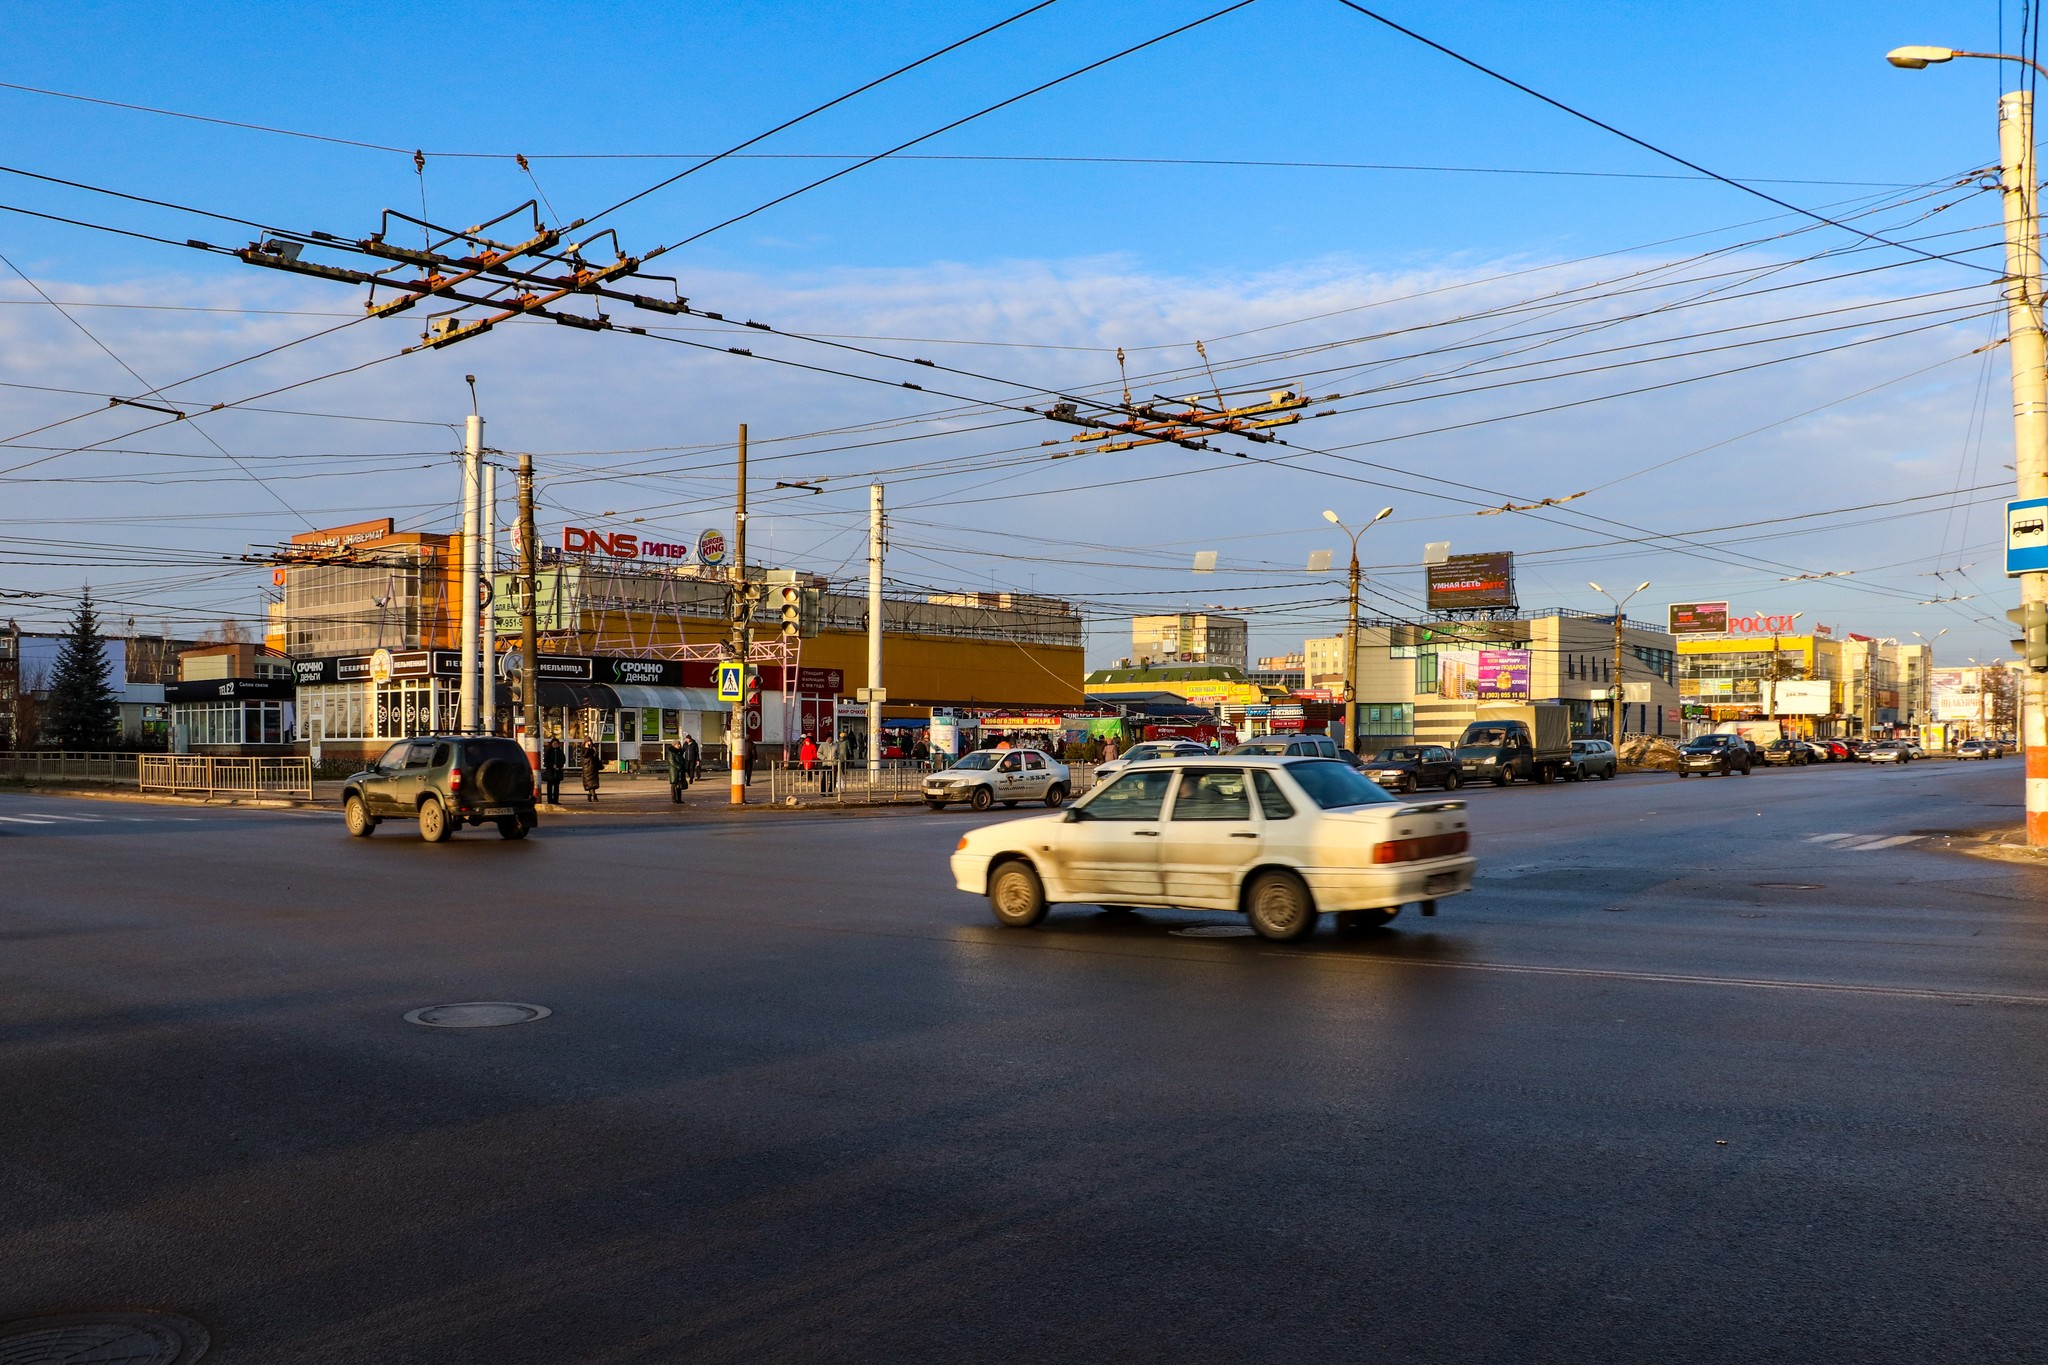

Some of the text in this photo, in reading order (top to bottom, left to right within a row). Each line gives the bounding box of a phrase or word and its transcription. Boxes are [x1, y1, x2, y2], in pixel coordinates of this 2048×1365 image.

[343, 529, 384, 546] УНИВЕРМАГ
[563, 526, 639, 559] DNS
[702, 536, 724, 548] BURGER
[641, 541, 687, 559] ГИПЕР
[702, 543, 725, 557] KING
[1432, 581, 1481, 590] УМНАЯ СЕТЬ
[296, 661, 324, 673] СРОЧНО
[340, 660, 427, 673] ПЕКАРНЯ ПЕЛЬМЕННАЯ
[540, 663, 583, 674] МЕЛЬНИЦА
[620, 661, 663, 674] СРОЧНО
[218, 682, 235, 696] TELE2
